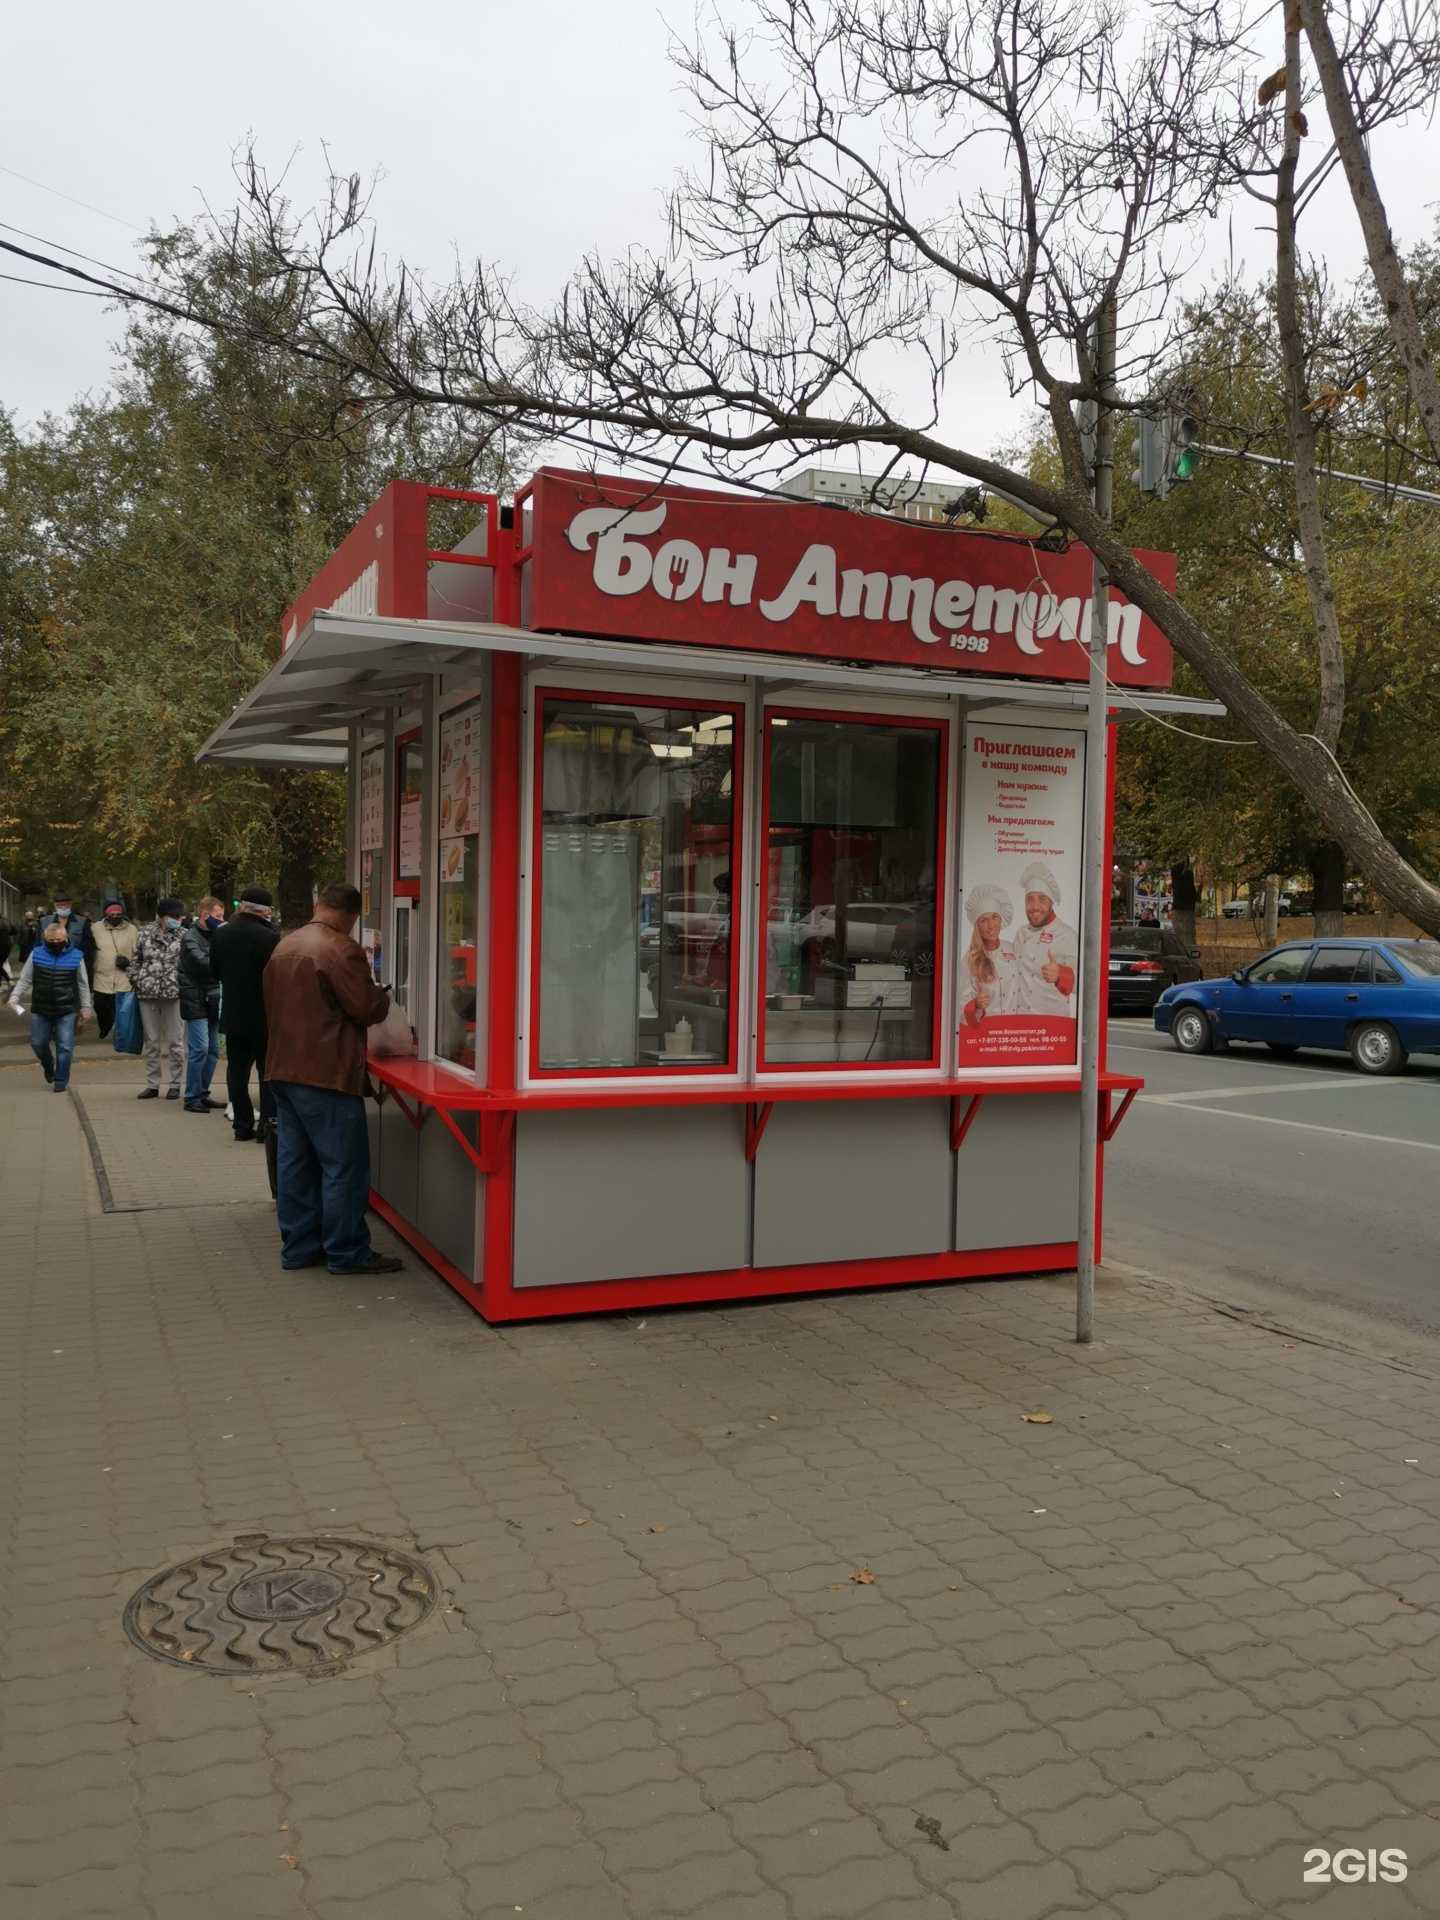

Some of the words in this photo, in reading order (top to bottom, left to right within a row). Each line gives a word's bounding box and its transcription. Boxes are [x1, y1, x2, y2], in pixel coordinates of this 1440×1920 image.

[564, 501, 758, 606] Бон
[759, 543, 1148, 666] Аппетит
[950, 633, 990, 653] 1998
[974, 737, 1076, 759] Приглашаем
[982, 761, 988, 769] в
[990, 761, 1019, 773] нашу
[1021, 764, 1068, 776] команду
